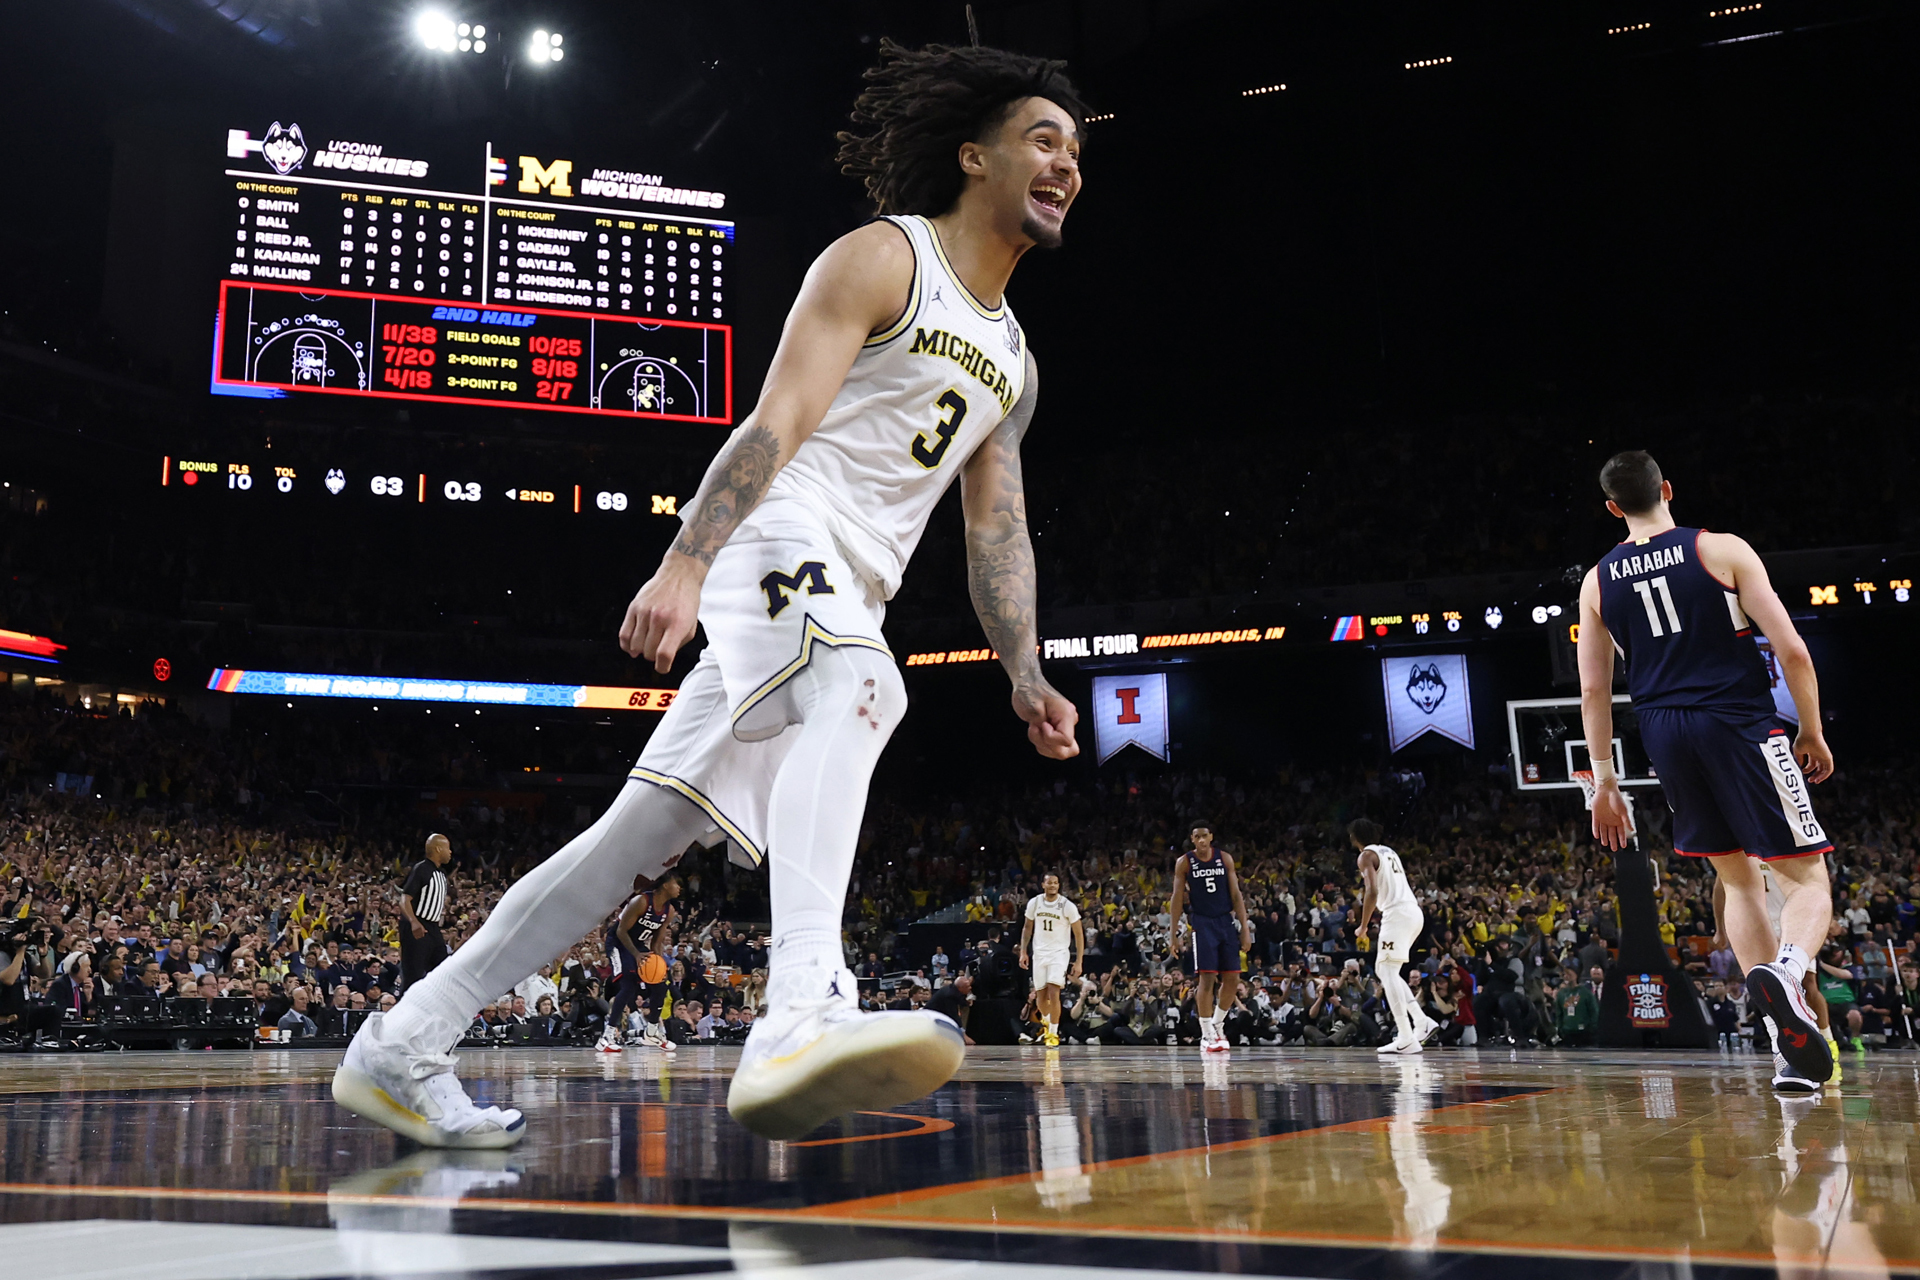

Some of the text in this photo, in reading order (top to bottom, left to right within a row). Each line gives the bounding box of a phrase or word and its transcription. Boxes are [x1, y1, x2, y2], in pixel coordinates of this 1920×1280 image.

[328, 140, 382, 155] UCONN
[313, 150, 429, 178] HUSKIES
[518, 156, 572, 196] M
[592, 169, 663, 186] MICHIGAN
[236, 182, 298, 195] ON THE COURT
[581, 179, 726, 209] WOLVERINES
[239, 197, 474, 230] 0 SMITH 3 3 0 2
[341, 193, 478, 213] PTS REB AST STL BLK FLS
[510, 210, 526, 218] THE
[527, 212, 556, 221] COURT
[256, 215, 474, 247] BALL 11 0 0 0 0 4
[596, 219, 612, 227] PTS
[619, 221, 635, 229] REB
[665, 226, 680, 234] STL
[687, 228, 703, 236] BLK
[710, 230, 725, 238] FLS
[237, 230, 473, 263] 5 REED JR. 13 14 0 0 3
[518, 225, 722, 255] MCKENNEY 9 8 0 0 0
[236, 247, 449, 277] 11 KARABAN 17 11 2 0
[499, 240, 722, 271] 3 CADEAU 19 3 2 2 0 3
[230, 263, 472, 296] 24 MULLINS 11 7 2 0 2
[499, 256, 722, 286] 11 GAYLE JR. 4 4 2 0 2 2
[497, 272, 722, 302] 21 JOHNSON JR. 12 10 0 2 4
[494, 288, 722, 318] 23 LENDEBORG 13 2 0 3
[432, 307, 537, 328] 2ND HALF
[383, 324, 582, 357] 11/38 FIELD GOALS 10/25
[382, 346, 578, 379] 7/20 2-POINT FG 8/18
[908, 327, 1015, 419] MICHIGAN
[384, 368, 573, 401] 4/18 3-POINT FG 2/7
[909, 387, 968, 471] 3
[179, 461, 218, 473] BONUS
[228, 464, 296, 478] FLS TOL
[228, 474, 292, 492] 10 0
[370, 476, 404, 496] 63
[444, 481, 555, 502] 0.3 2ND
[596, 492, 676, 515] 69 M
[1609, 544, 1685, 581] KARABAN
[759, 561, 836, 622] M
[1809, 585, 1839, 605] M
[1853, 579, 1912, 592] TOL FLS
[1895, 588, 1910, 602] 8
[1412, 611, 1462, 623] FLS TOL
[1632, 575, 1682, 638] 11
[1370, 615, 1402, 626] BONUS
[1415, 620, 1460, 634] 10 0
[1044, 636, 1090, 659] FINAL
[1093, 634, 1138, 656] FOUR
[1142, 626, 1285, 649] INDIANAPOLIS, IN
[906, 652, 945, 666] 2026
[947, 650, 989, 663] NCAA
[284, 678, 330, 692] THE
[331, 680, 399, 695] ROAD
[629, 692, 650, 707] 68
[1116, 688, 1141, 724] I
[1772, 743, 1819, 838] HUSKIES
[1192, 868, 1224, 878] UCONN
[1205, 877, 1217, 893] 5
[1037, 912, 1060, 920] MICHIGAN
[1043, 919, 1053, 931] 11
[1382, 941, 1394, 950] M
[1629, 984, 1662, 996] FINAL
[1634, 1008, 1665, 1019] FOUR
